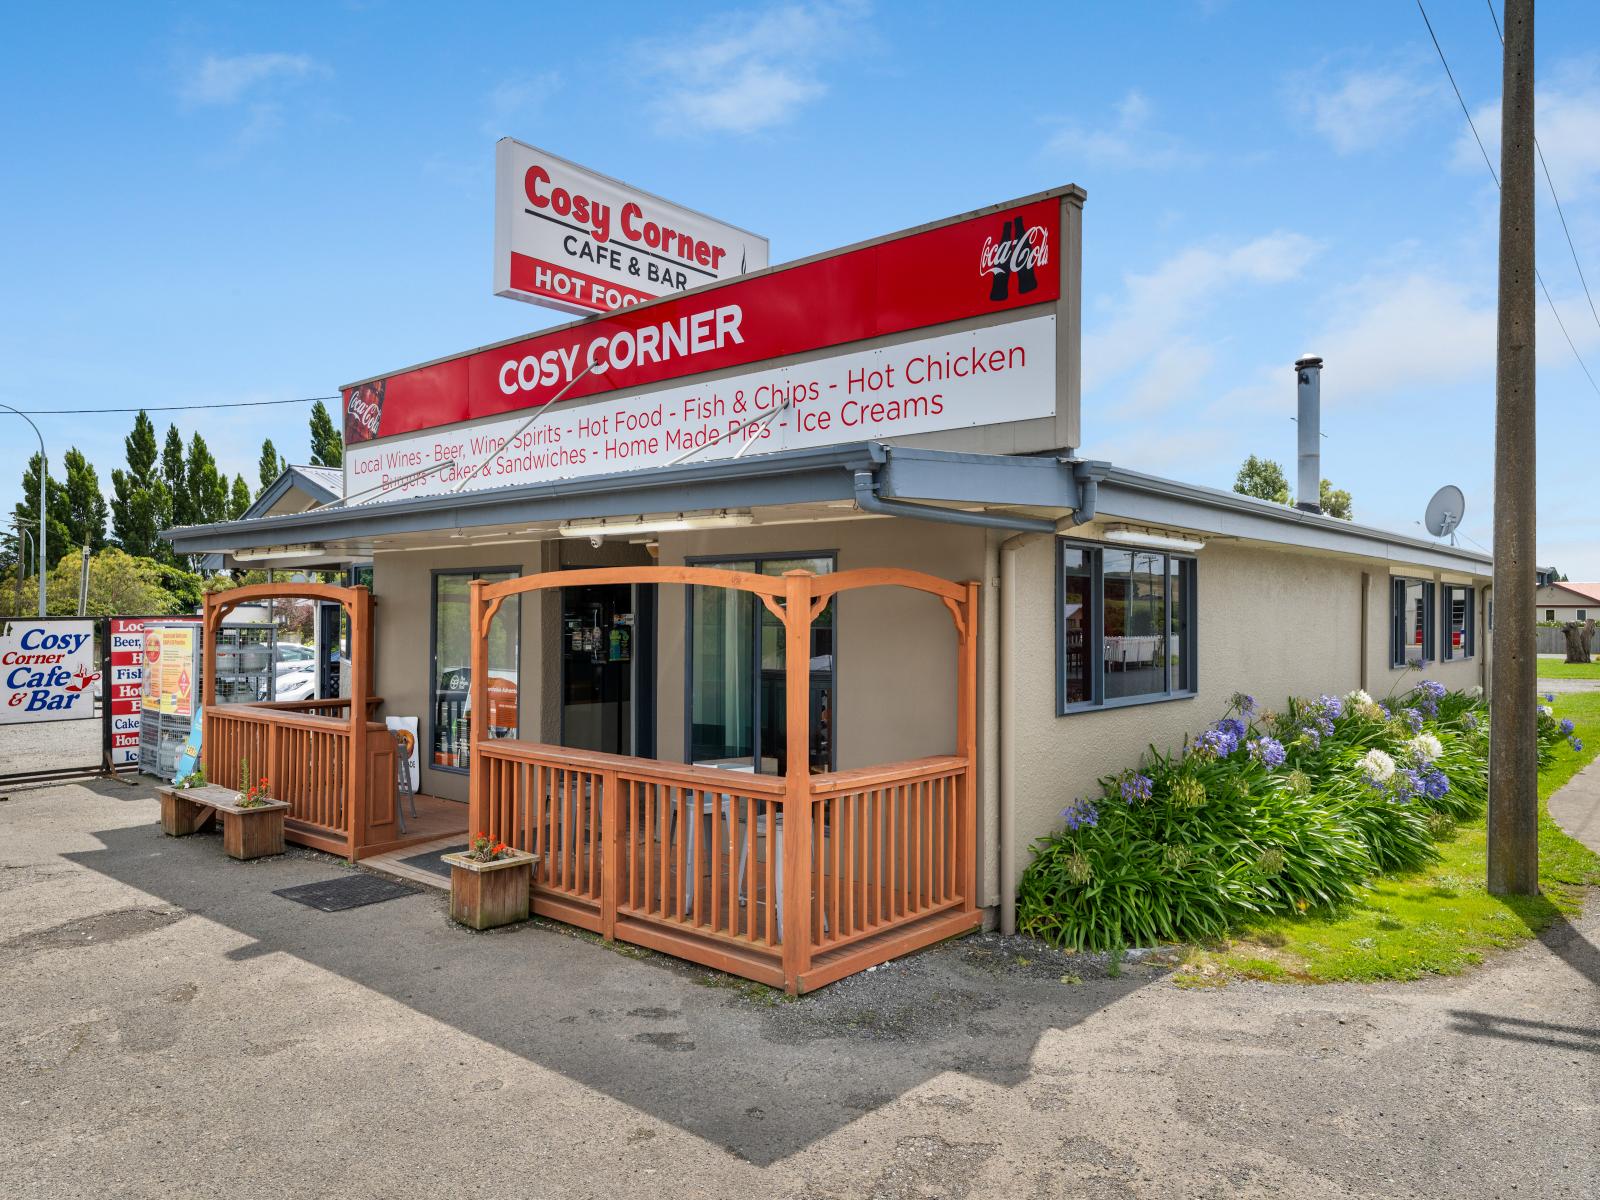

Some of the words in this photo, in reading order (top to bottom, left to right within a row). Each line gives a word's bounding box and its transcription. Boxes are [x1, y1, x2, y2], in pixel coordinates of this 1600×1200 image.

[524, 165, 610, 243] Cosy
[620, 202, 726, 270] Corner
[563, 235, 622, 271] CAFE
[628, 256, 641, 277] &
[648, 262, 687, 290] BAR
[535, 266, 585, 299] HOT
[591, 284, 648, 309] FOO
[499, 345, 580, 394] COSY
[586, 304, 745, 375] CORNER
[354, 455, 382, 475] Local
[386, 450, 421, 469] Wines
[434, 443, 465, 462] Beer,
[470, 435, 509, 455] Wine,
[514, 424, 561, 452] Spirits
[578, 415, 608, 439] Hot
[615, 404, 663, 432] Food
[684, 394, 725, 421] Fish
[732, 390, 747, 414] &
[754, 380, 819, 410] Chips
[848, 364, 895, 395] Hot
[905, 346, 1026, 385] Chicken
[440, 462, 478, 483] Cakes
[482, 462, 492, 477] &
[496, 445, 586, 475] Sandwiches
[605, 436, 659, 460] Home
[666, 423, 720, 452] Made
[728, 418, 771, 444] Pies
[797, 409, 831, 433] Ice
[841, 394, 943, 427] Creams
[118, 620, 144, 632] Loc
[20, 628, 91, 655] Cosy
[113, 636, 141, 649] Beer,
[2, 651, 65, 666] Corner
[6, 665, 71, 690] Cafe
[8, 692, 28, 707] &
[24, 689, 80, 712] Bar
[114, 718, 140, 730] Cake
